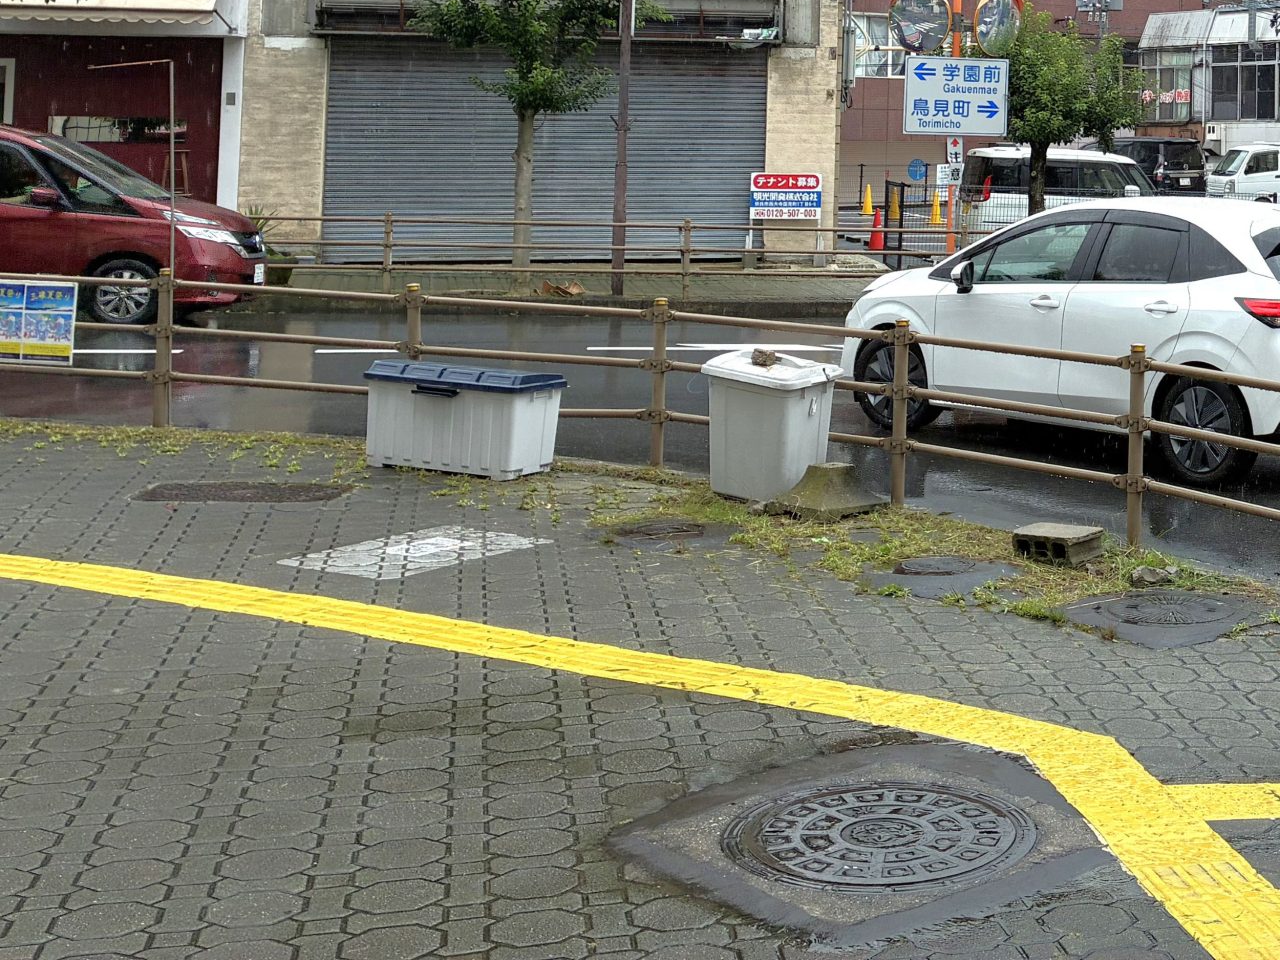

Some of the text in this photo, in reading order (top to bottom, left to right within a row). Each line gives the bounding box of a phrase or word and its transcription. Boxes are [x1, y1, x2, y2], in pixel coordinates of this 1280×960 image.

[942, 63, 1001, 84] 学園前
[942, 83, 998, 95] Gakuenmae
[911, 98, 971, 118] 鳥見町
[917, 118, 961, 129] Torimicho
[756, 176, 817, 187] テナント募集
